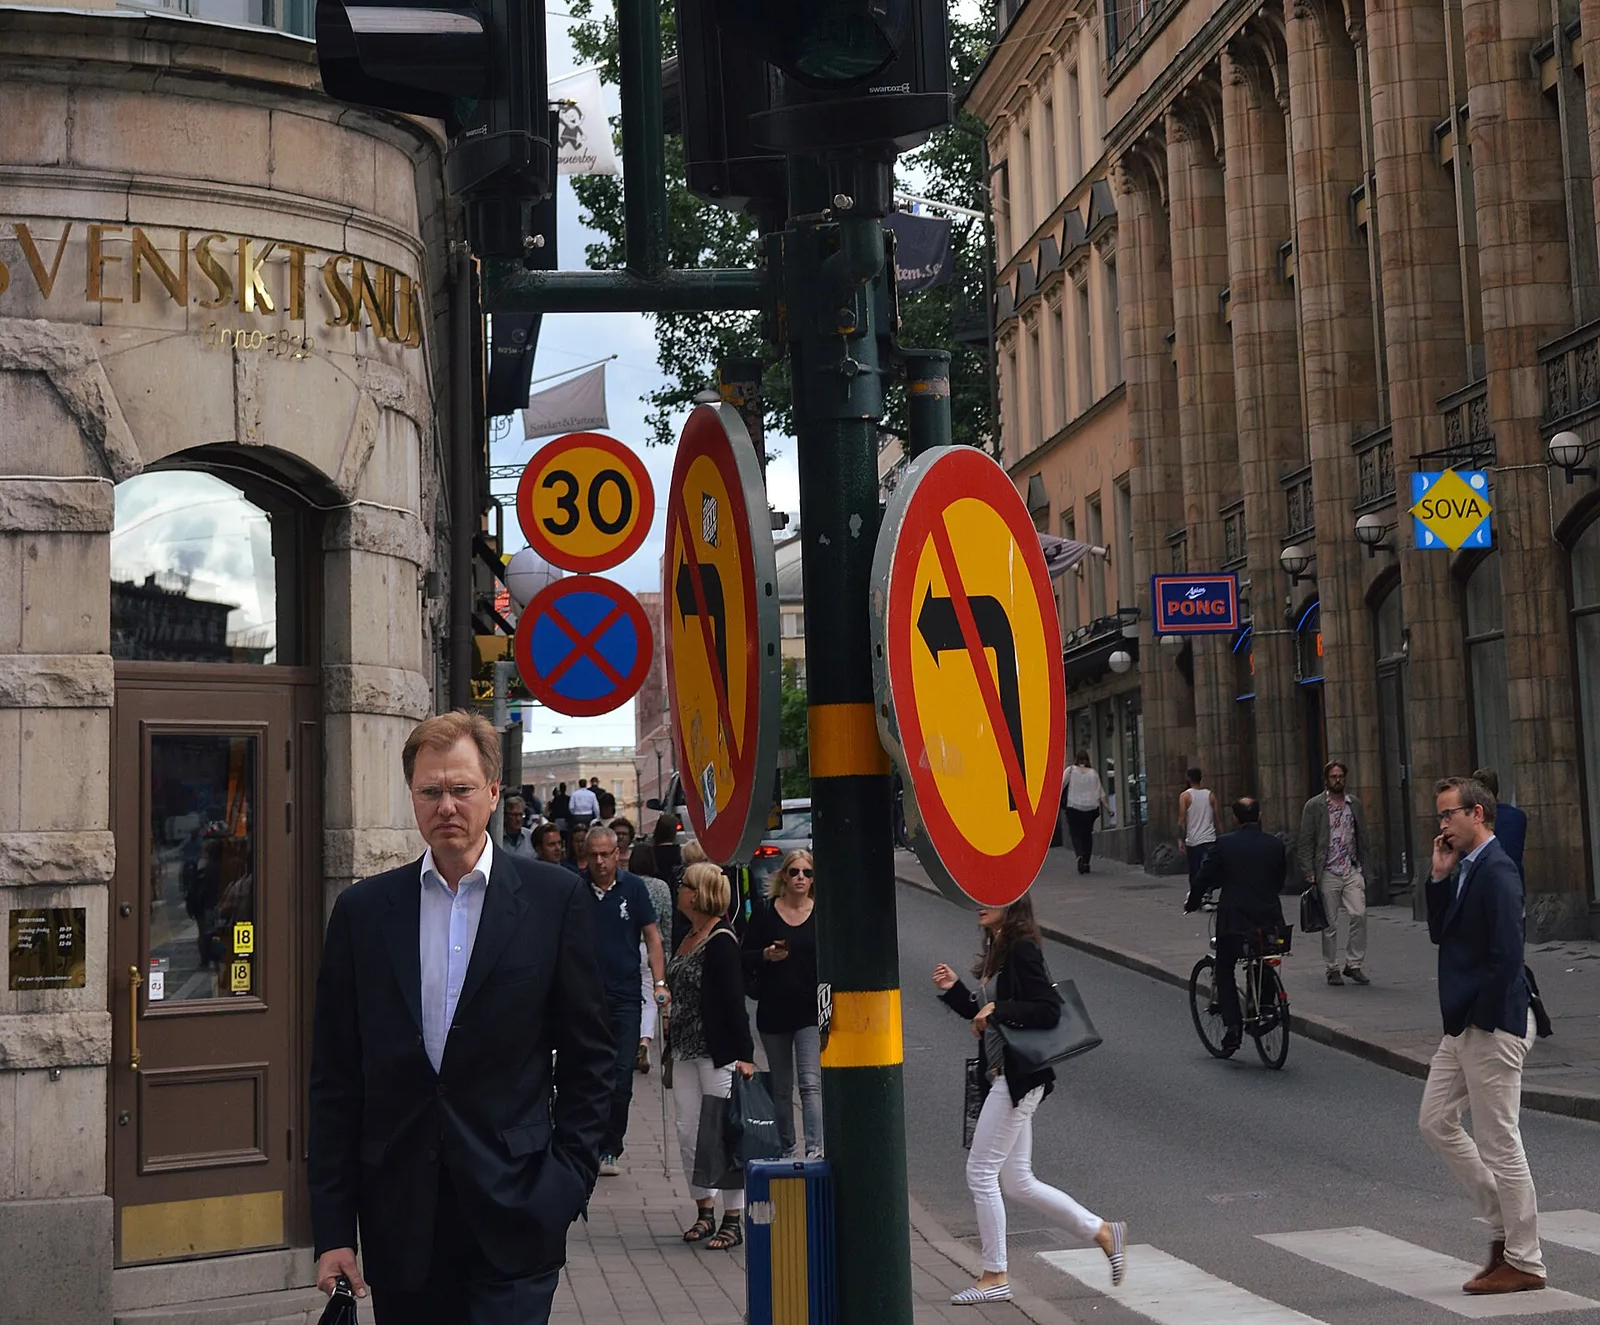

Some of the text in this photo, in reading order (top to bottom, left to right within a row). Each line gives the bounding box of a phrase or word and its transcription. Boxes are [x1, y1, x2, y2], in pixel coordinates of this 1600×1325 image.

[542, 468, 632, 536] 30
[1421, 498, 1483, 521] SOVA
[1167, 599, 1226, 616] PONG
[237, 930, 250, 944] 18
[234, 965, 247, 979] 18
